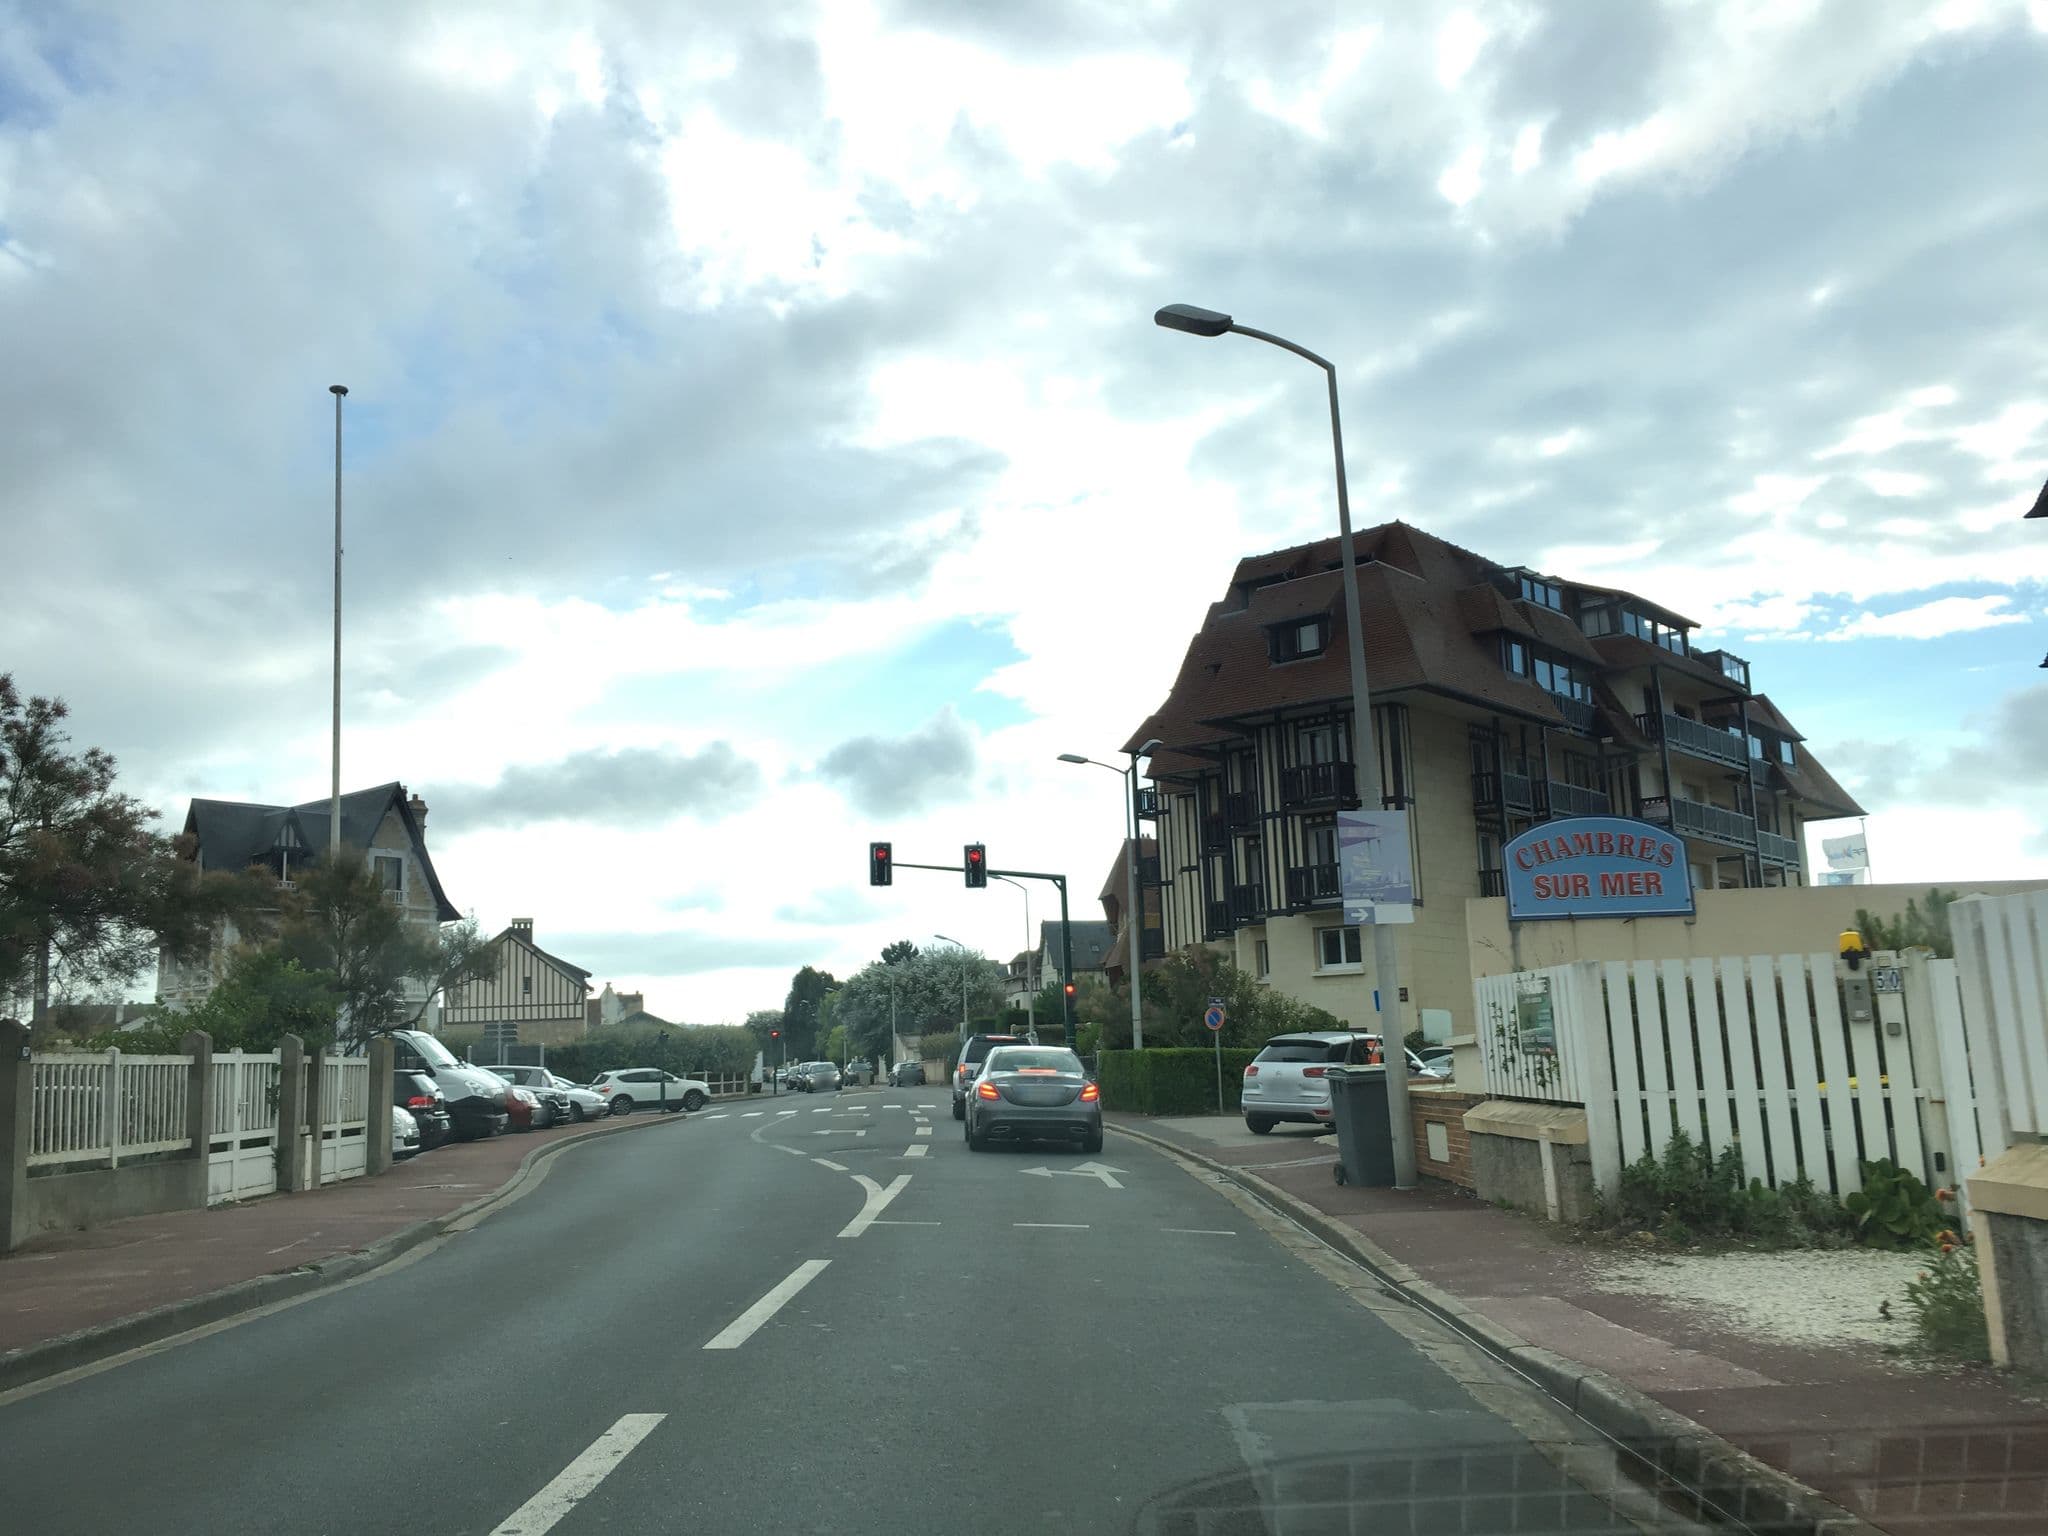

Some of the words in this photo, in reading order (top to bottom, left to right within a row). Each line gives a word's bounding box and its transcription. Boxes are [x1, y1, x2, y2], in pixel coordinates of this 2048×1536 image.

[1515, 832, 1674, 871] CHAMBRES
[1534, 874, 1591, 900] SUR
[1600, 871, 1664, 897] MER
